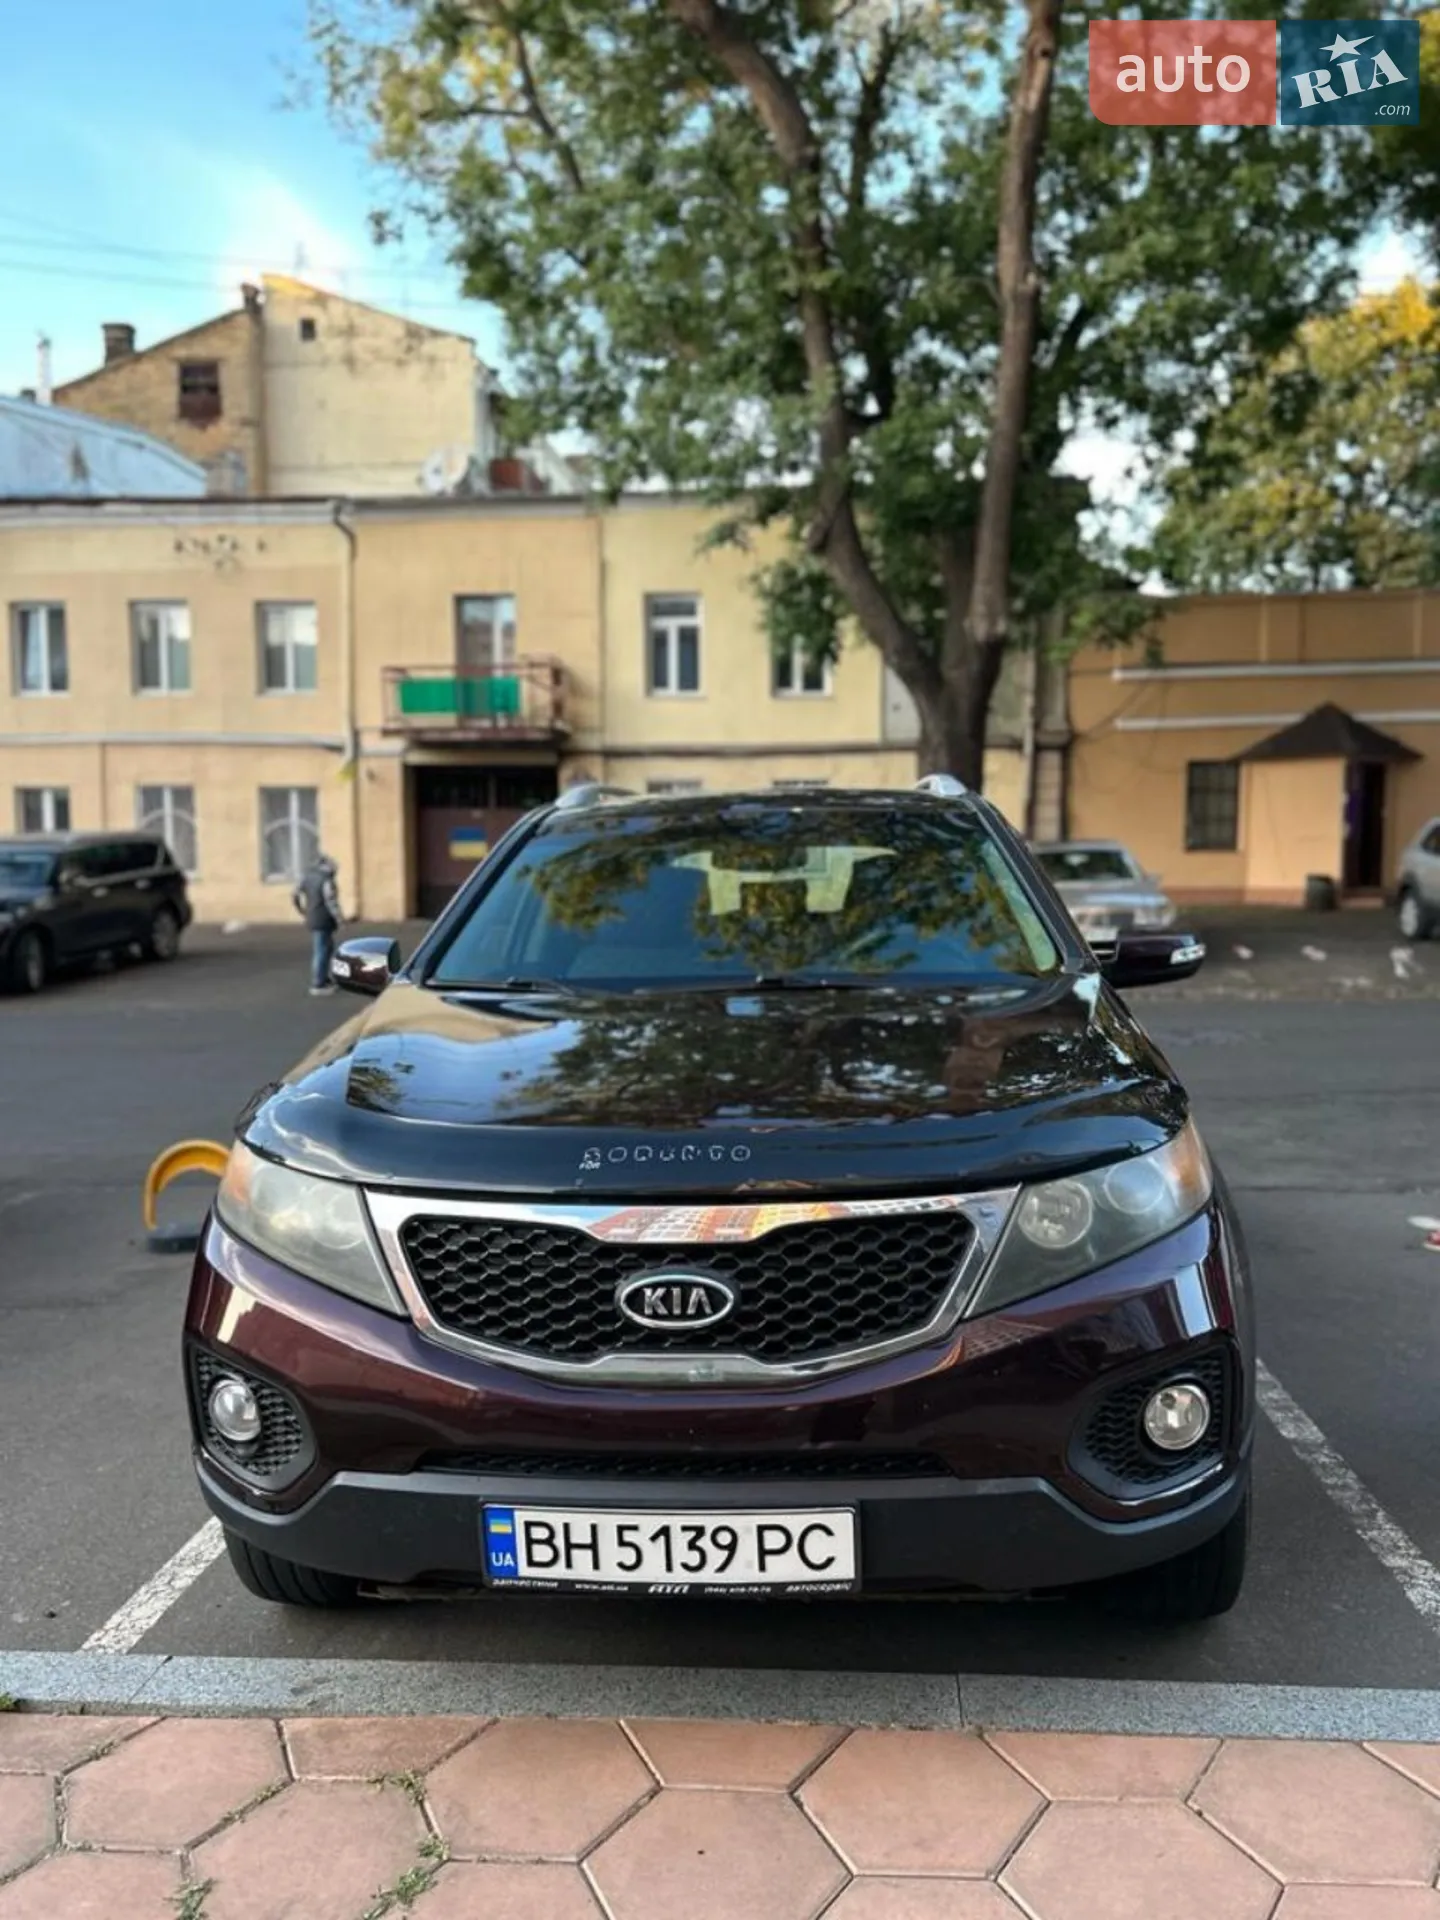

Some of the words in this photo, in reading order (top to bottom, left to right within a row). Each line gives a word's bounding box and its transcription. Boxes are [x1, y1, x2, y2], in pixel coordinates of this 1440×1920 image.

[643, 1287, 713, 1316] KIA
[491, 1553, 515, 1567] UA
[523, 1520, 601, 1571] BH
[616, 1523, 738, 1574] 5139
[756, 1522, 836, 1573] PC
